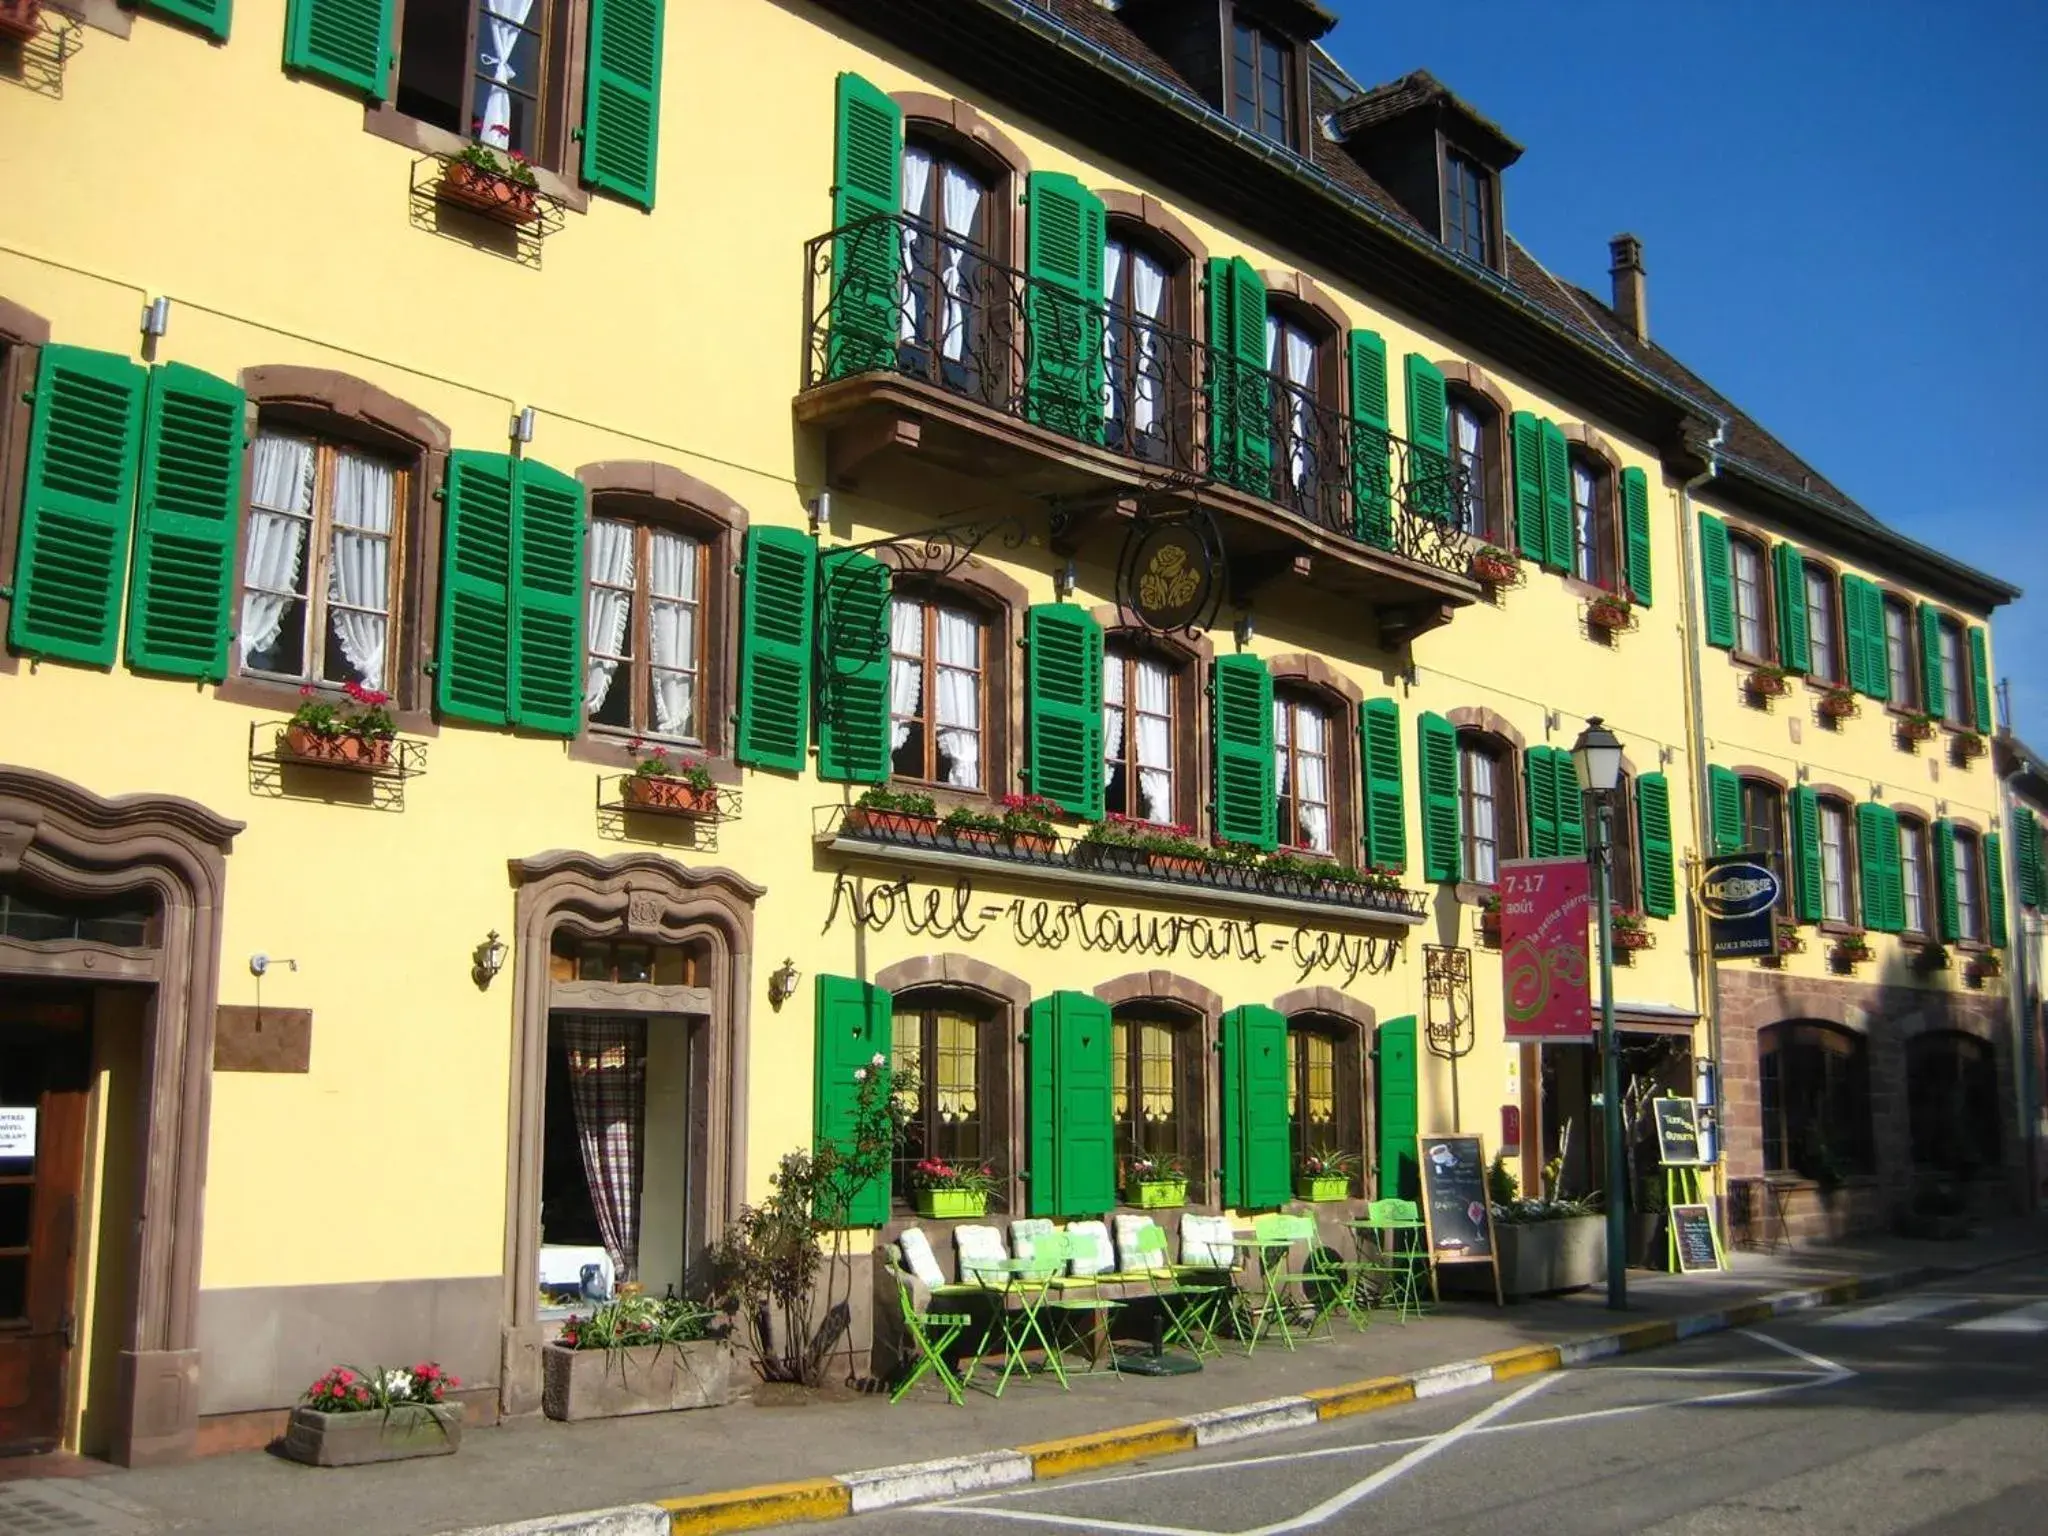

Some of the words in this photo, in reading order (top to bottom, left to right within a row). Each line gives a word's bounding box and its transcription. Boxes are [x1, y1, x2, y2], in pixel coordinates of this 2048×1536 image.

[1506, 899, 1534, 914] août
[1561, 893, 1588, 916] pierre
[1739, 938, 1770, 948] ROSES
